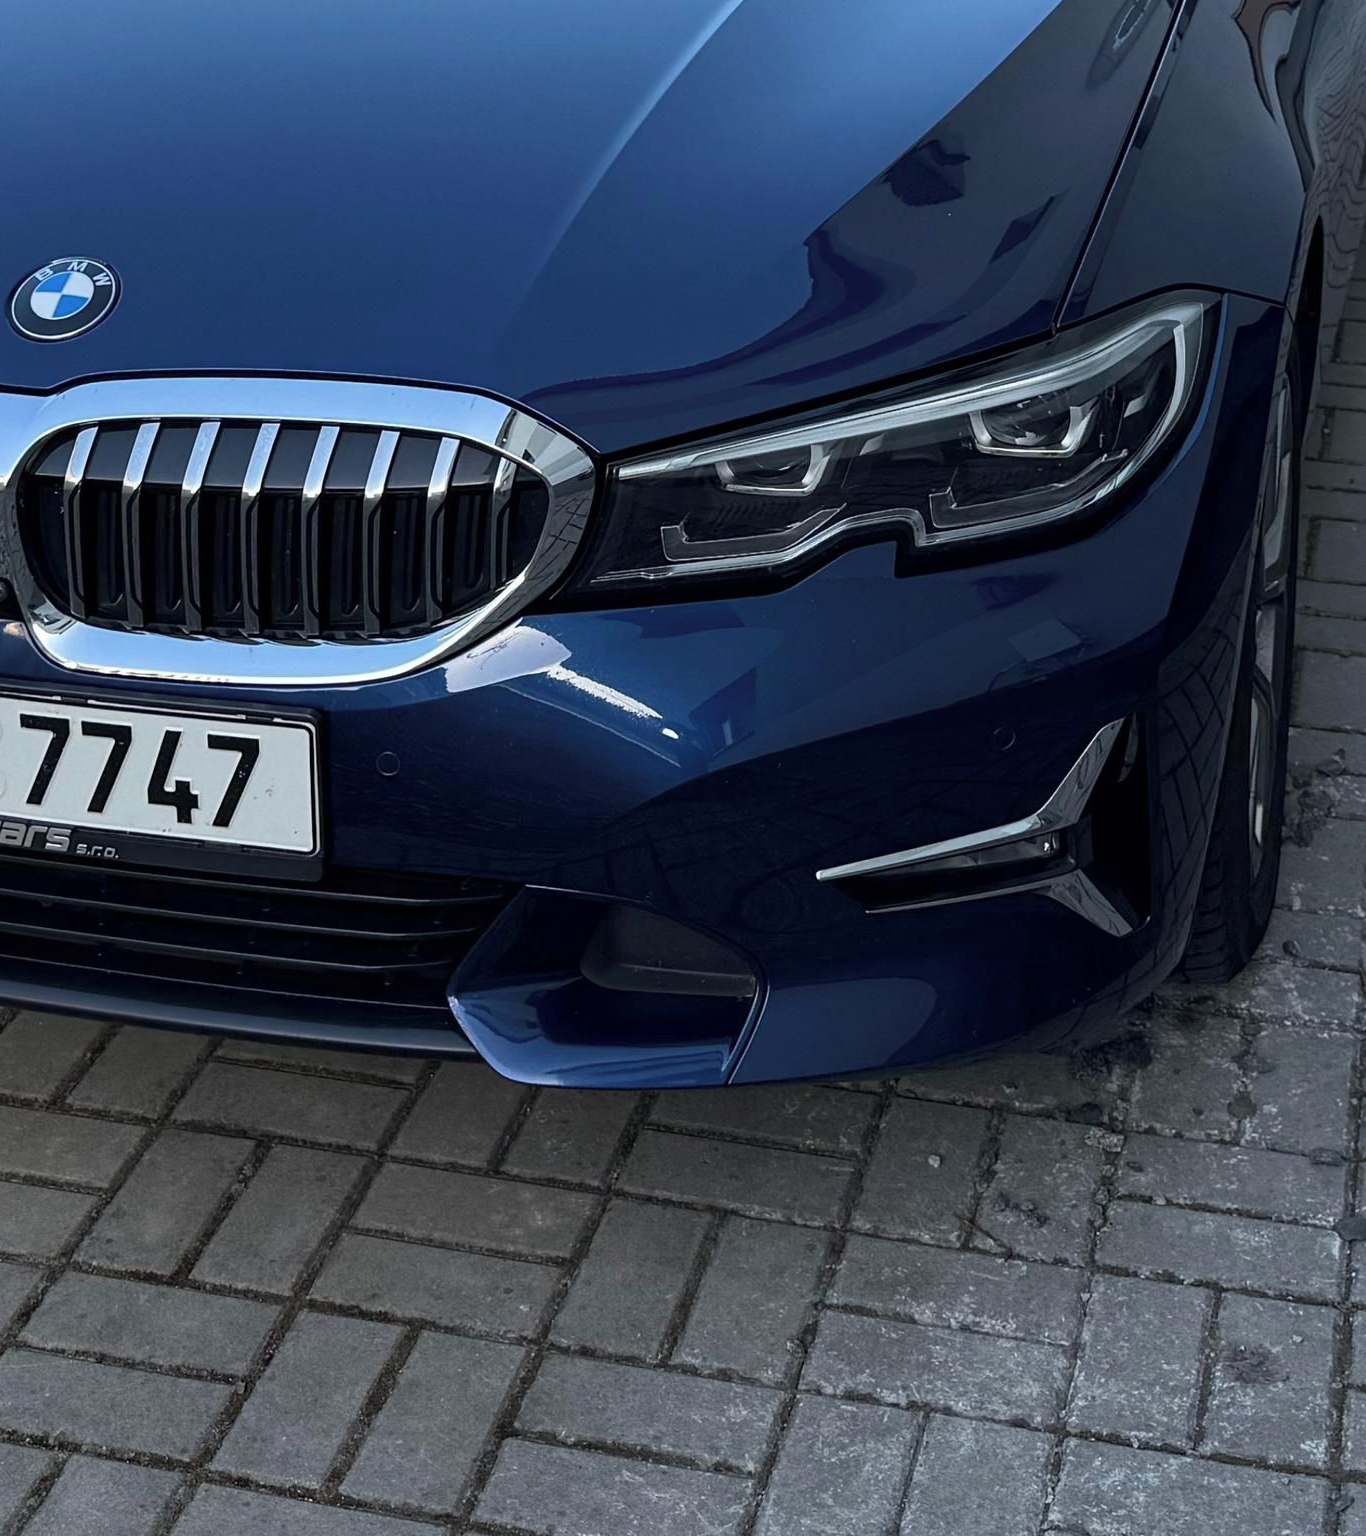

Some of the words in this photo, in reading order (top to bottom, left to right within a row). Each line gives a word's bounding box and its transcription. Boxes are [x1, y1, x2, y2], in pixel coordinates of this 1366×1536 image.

[34, 261, 112, 287] BMW
[19, 712, 261, 828] 7747
[76, 843, 120, 859] s.r.o.
